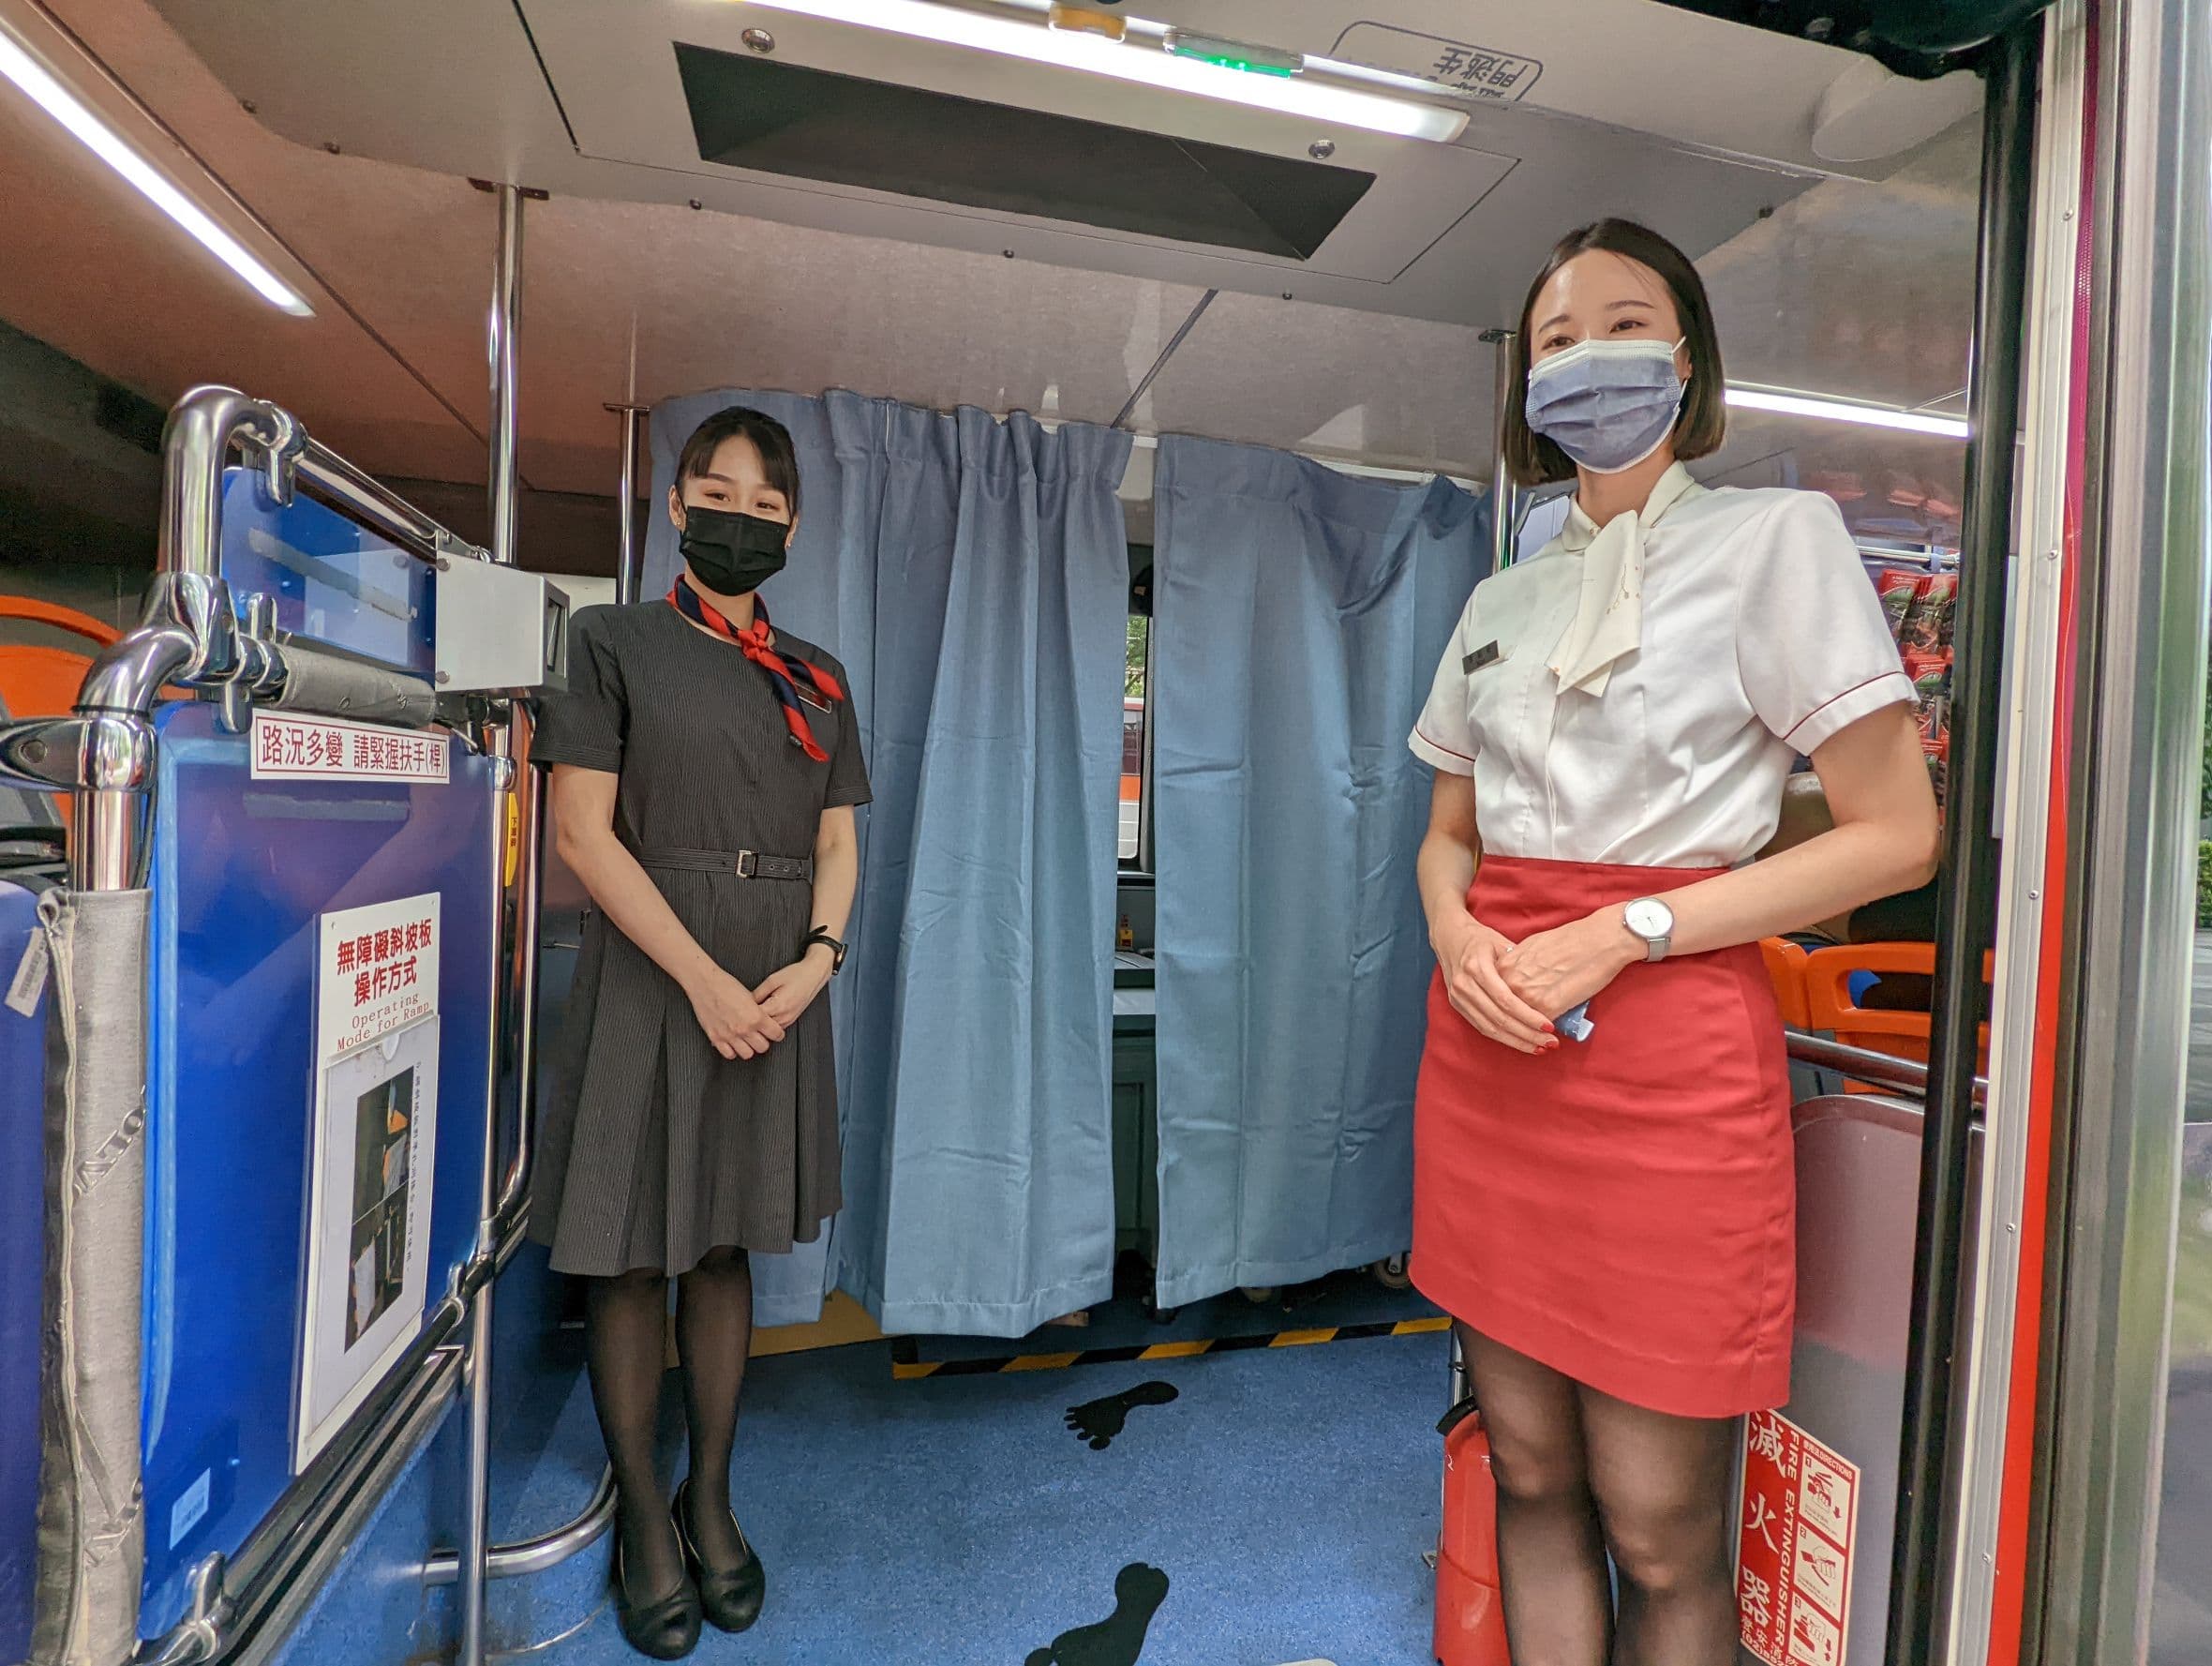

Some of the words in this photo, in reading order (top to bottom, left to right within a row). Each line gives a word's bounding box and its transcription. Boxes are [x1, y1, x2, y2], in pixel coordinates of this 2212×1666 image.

[262, 725, 343, 768] 路況多變
[353, 734, 445, 775] 請緊握扶手(桿)
[336, 918, 432, 976] 無障礙斜坡板
[353, 955, 417, 1007] 操作方式
[337, 1029, 370, 1052] Mode
[378, 1015, 398, 1032] for
[403, 1001, 429, 1021] Ramp
[351, 993, 419, 1029] Operating
[1787, 1430, 1800, 1481] FIRE
[1741, 1411, 1786, 1628] 滅火器
[1775, 1488, 1795, 1645] EXTINGUISHER
